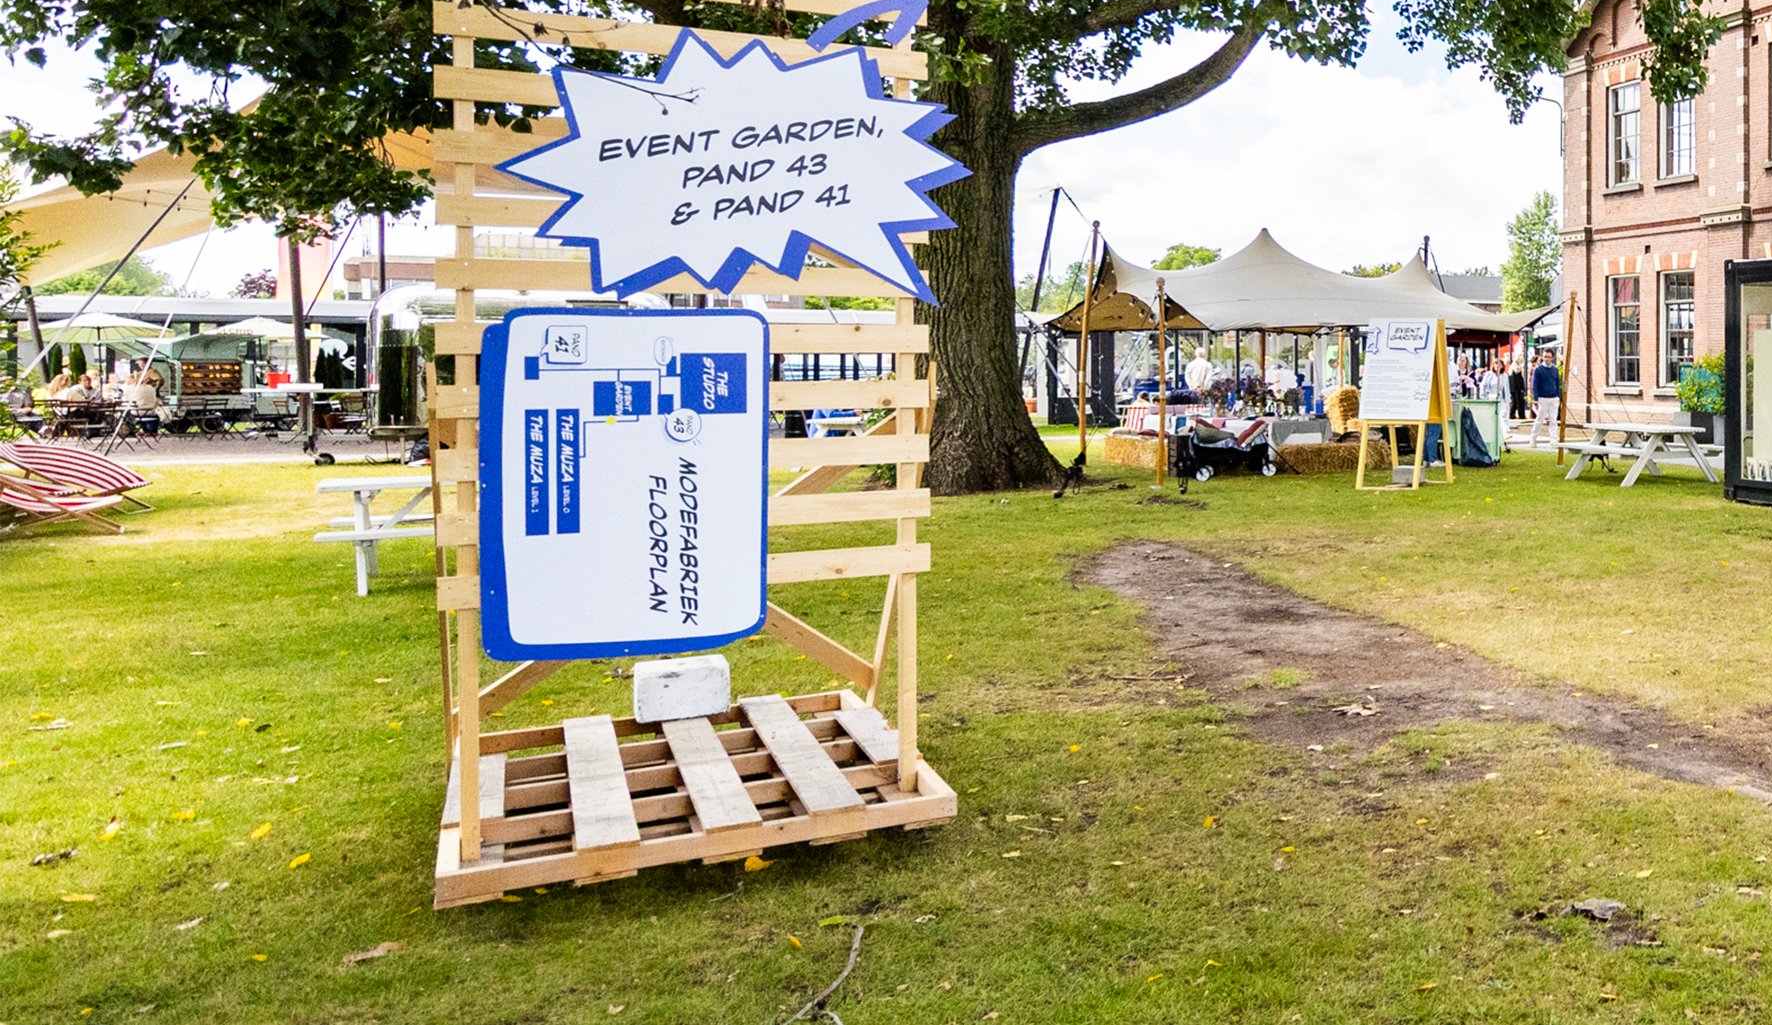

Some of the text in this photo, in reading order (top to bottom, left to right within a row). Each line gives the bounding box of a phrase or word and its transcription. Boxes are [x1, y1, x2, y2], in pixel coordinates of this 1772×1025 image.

[599, 115, 884, 162] EVENT GARDEN,
[682, 153, 828, 188] PAND 43
[670, 184, 851, 226] & PAND 41
[555, 336, 570, 353] 41
[570, 332, 582, 358] PAND
[614, 381, 625, 416] GARDEN
[624, 384, 634, 412] EVENT
[702, 356, 715, 411] STUDIO
[714, 370, 729, 398] THE
[530, 415, 544, 443] THE
[560, 414, 574, 442] THE
[672, 417, 685, 434] 43
[529, 445, 544, 484] MUZA
[560, 444, 575, 483] MUZA
[531, 486, 540, 507] LEVEL
[562, 485, 571, 507] LEVEL
[649, 475, 668, 613] FLOORPLAN
[679, 457, 698, 626] MODEFABRIEK
